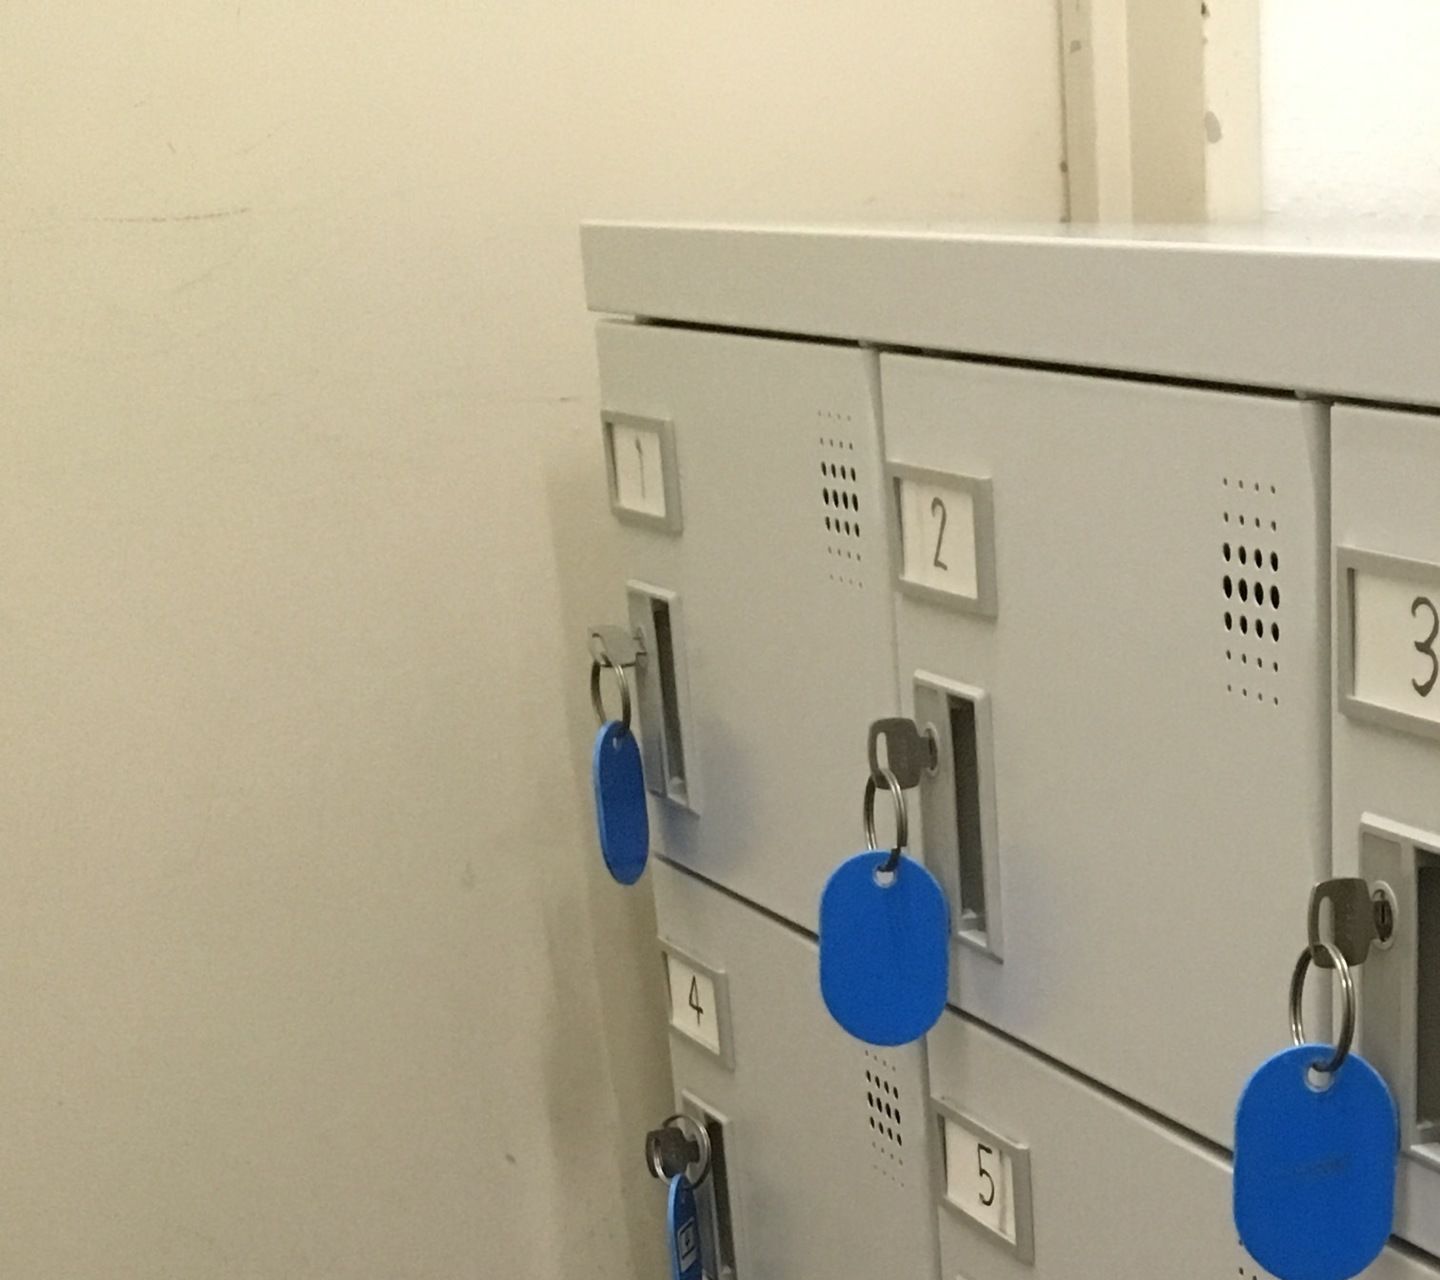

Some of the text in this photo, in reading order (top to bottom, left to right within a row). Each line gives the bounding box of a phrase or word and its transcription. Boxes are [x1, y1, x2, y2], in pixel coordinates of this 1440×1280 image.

[635, 438, 645, 498] 1
[931, 496, 948, 570] 2
[1410, 595, 1440, 697] 3
[688, 975, 703, 1026] 4
[976, 1144, 995, 1206] 5
